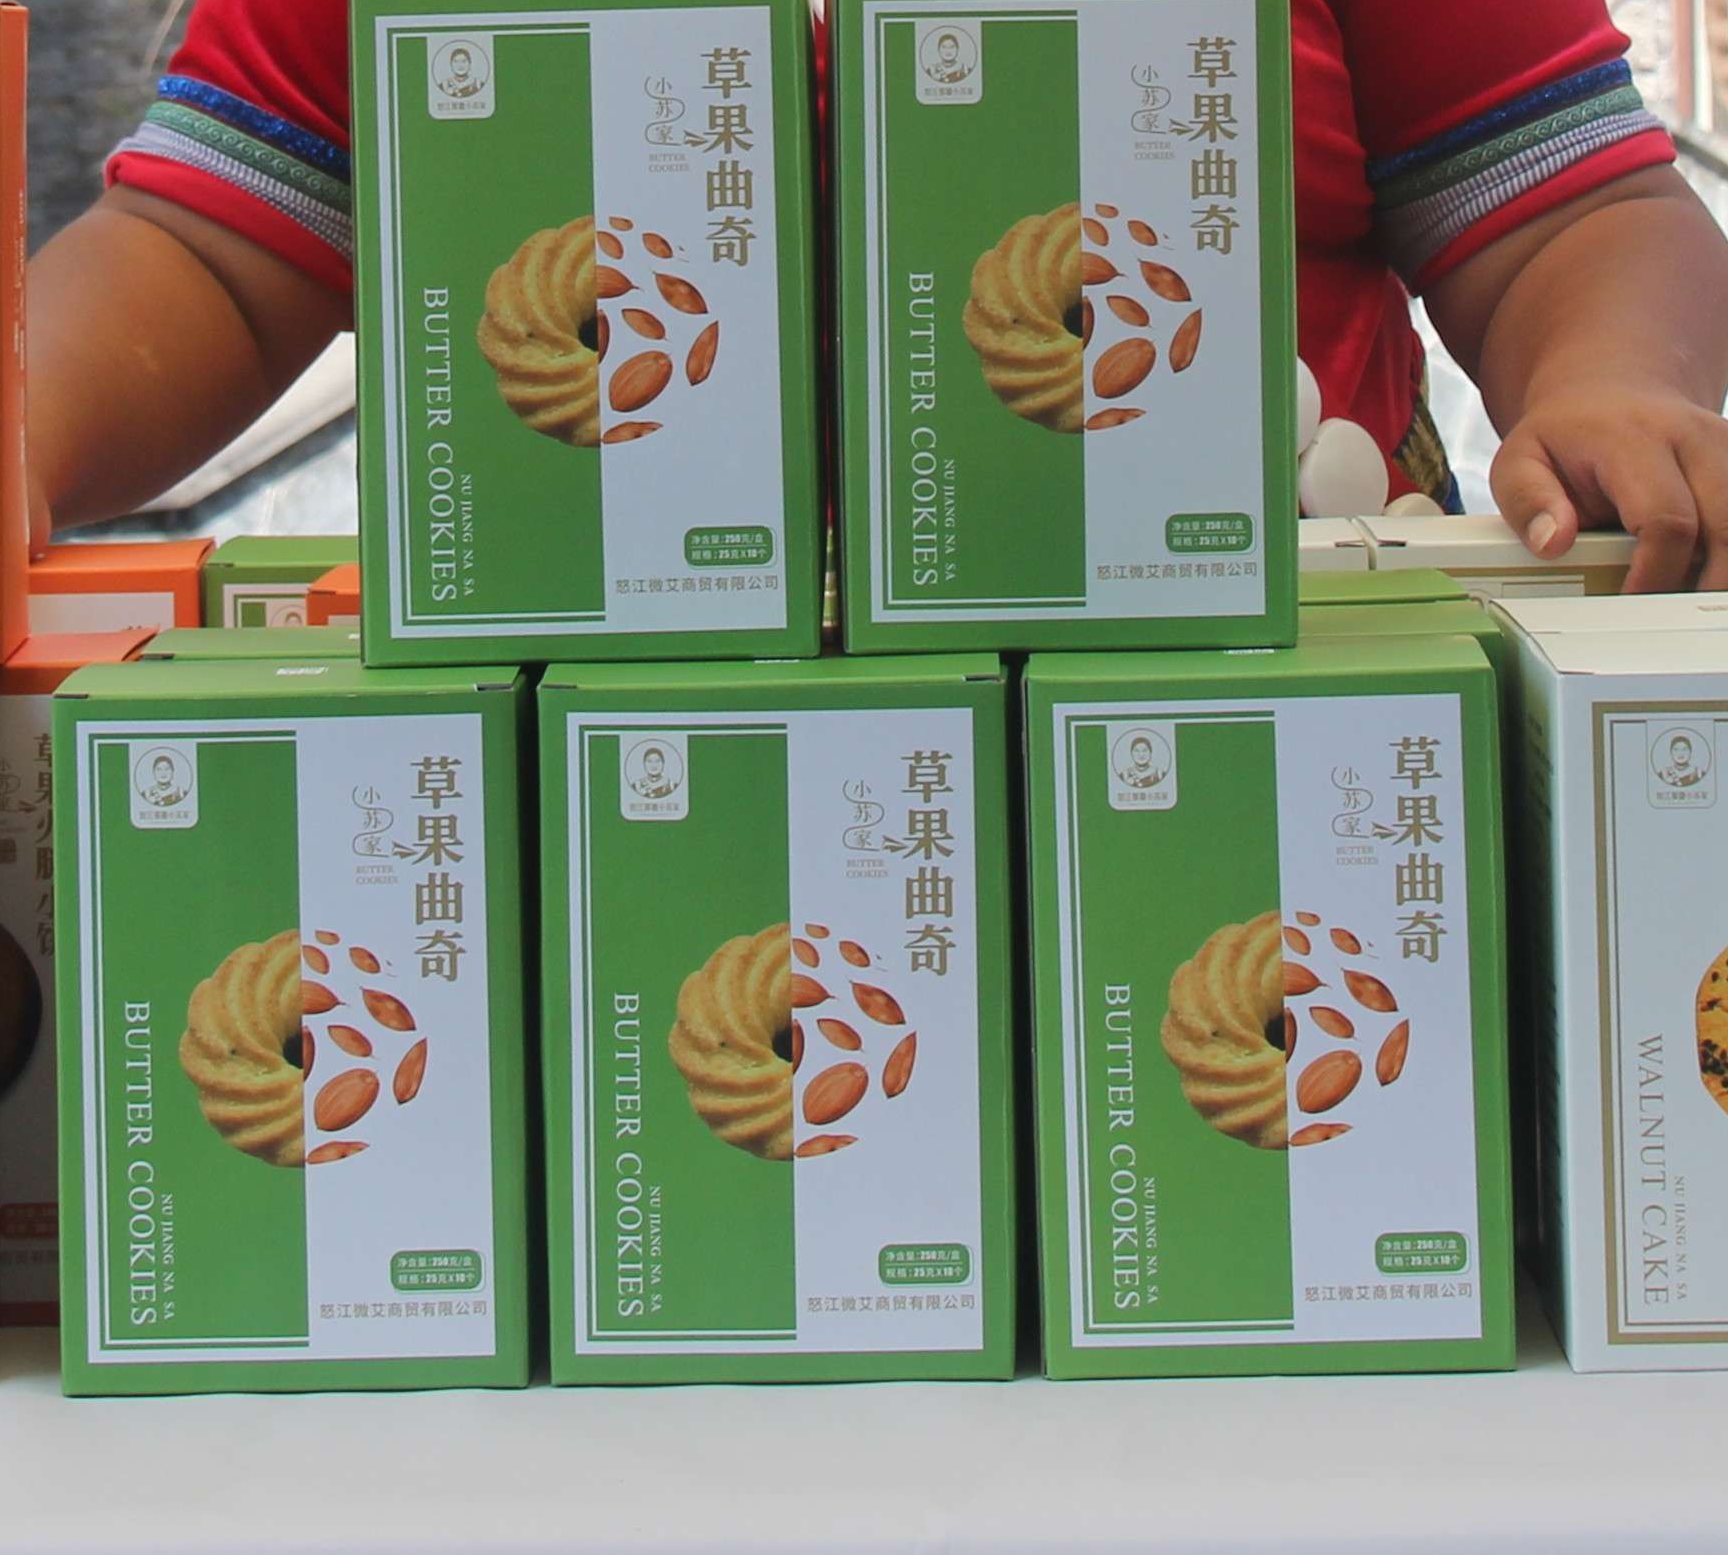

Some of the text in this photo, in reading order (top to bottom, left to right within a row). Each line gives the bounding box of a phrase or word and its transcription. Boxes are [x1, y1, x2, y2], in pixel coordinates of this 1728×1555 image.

[655, 77, 674, 143] 小苏家
[700, 47, 757, 267] 草果曲奇
[1141, 65, 1160, 131] 小苏家
[1186, 37, 1240, 254] 草果曲奇
[424, 287, 457, 601] BUTTER COOKIES
[909, 272, 938, 586] BUTTER COOKIES
[460, 474, 474, 597] NU JIANG NA SA
[943, 459, 956, 581] NU JIANG NA SA
[1097, 559, 1257, 579] 怒江微艾商贸有限公司
[616, 575, 778, 594] 怒江微艾商贸有限公司
[363, 786, 382, 854] 小苏家
[853, 780, 872, 848] 小苏家
[900, 750, 956, 976] 草果曲奇
[1342, 767, 1362, 835] 小苏家
[1388, 736, 1448, 963] 草果曲奇
[409, 756, 467, 982] 草果曲奇
[124, 1002, 157, 1325] BUTTER COOKIES
[614, 993, 644, 1316] BUTTER COOKIES
[1105, 984, 1140, 1309] BUTTER COOKIES
[1638, 1034, 1669, 1304] WALNUT CAKE
[161, 1194, 175, 1320] NU JIANG NA SA
[649, 1186, 662, 1312] NU JIANG NA SA
[808, 1294, 975, 1312] 怒江微艾商贸有限公司
[1143, 1177, 1159, 1305] NU JIANG NA SA
[1305, 1282, 1472, 1302] 怒江微艾商贸有限公司
[320, 1300, 487, 1319] 怒江微艾商贸有限公司
